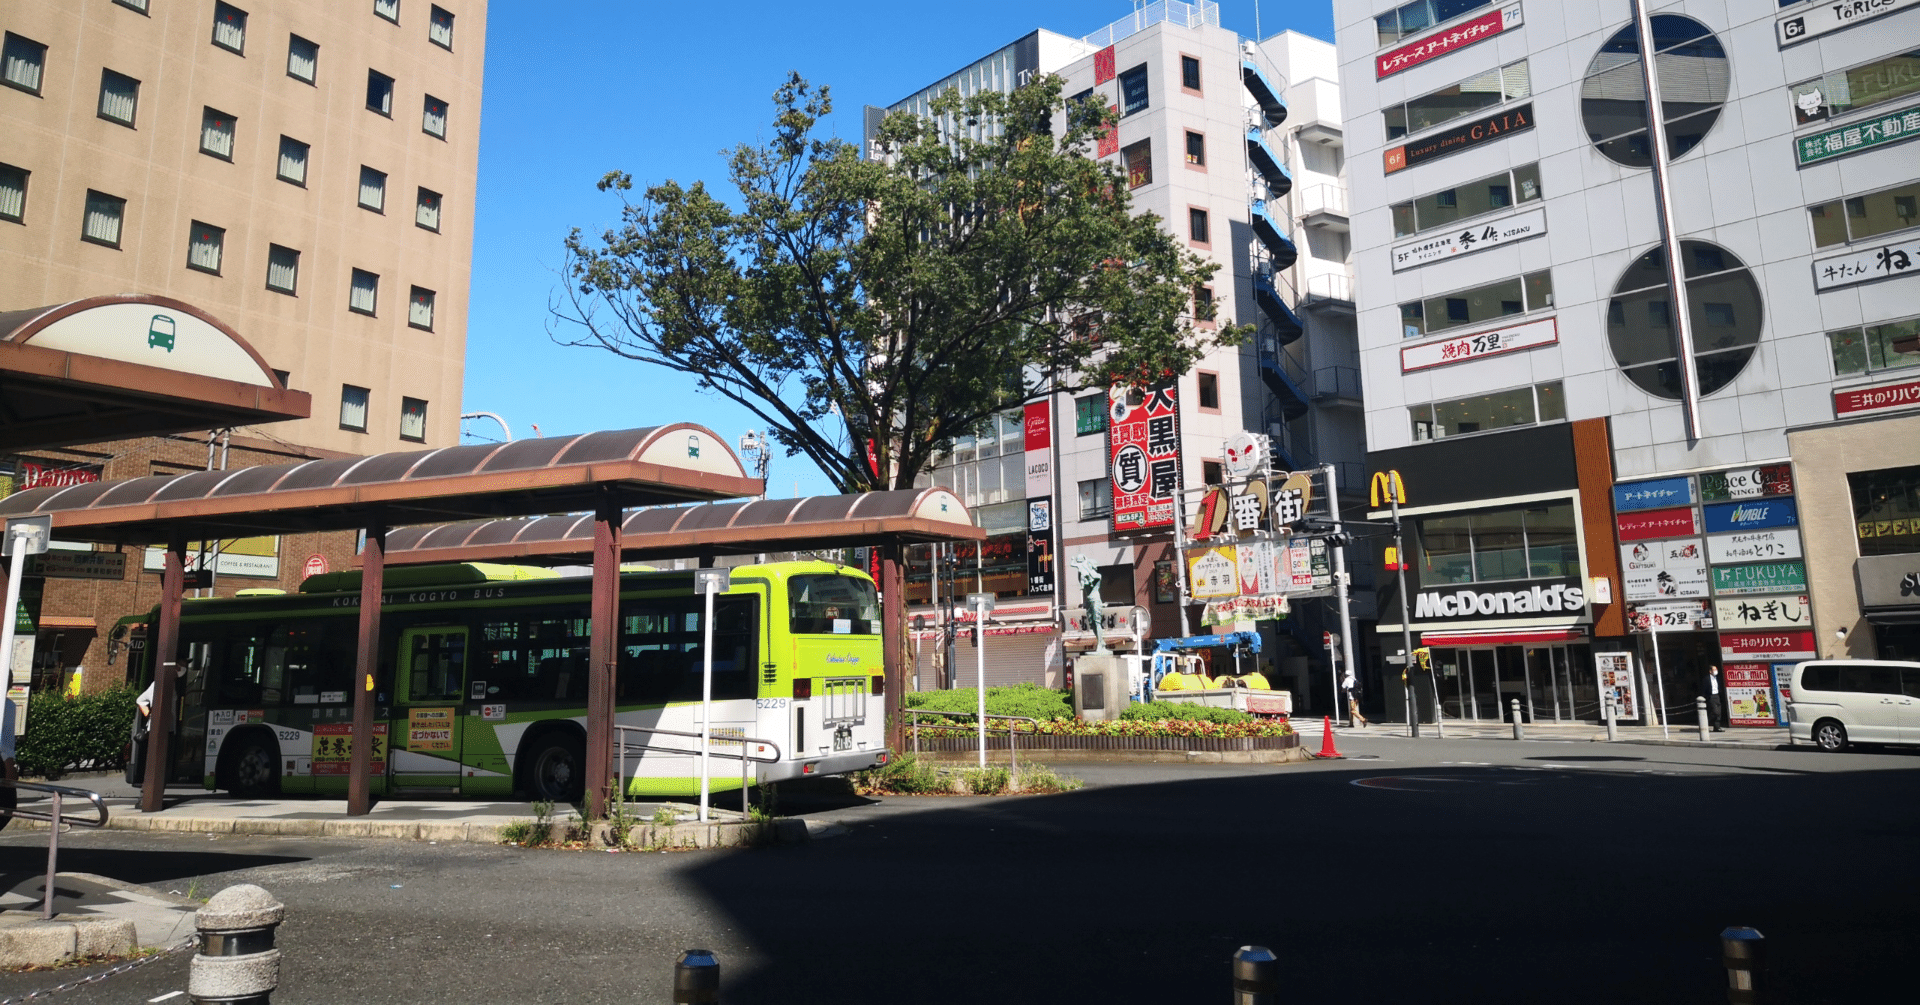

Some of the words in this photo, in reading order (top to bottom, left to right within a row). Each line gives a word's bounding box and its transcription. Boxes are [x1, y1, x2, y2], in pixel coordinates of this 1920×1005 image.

[1786, 22, 1803, 36] 6F
[1382, 46, 1425, 70] レディース
[1427, 22, 1496, 53] アートネイチャー
[1503, 9, 1520, 22] 7F
[1389, 153, 1401, 165] 6F
[1410, 142, 1438, 157] Luxury
[1440, 134, 1466, 148] dining
[1470, 112, 1527, 140] GAIA
[1825, 112, 1920, 152] 福屋不動産
[1398, 252, 1409, 262] 5F
[1503, 225, 1531, 238] KISAKU
[1823, 261, 1867, 281] 牛たん
[1877, 247, 1920, 275] ね
[1119, 422, 1146, 444] 買取
[1145, 378, 1178, 502] 大黒屋
[1028, 463, 1049, 475] LACOCO
[1119, 451, 1143, 487] 質
[1625, 489, 1678, 501] アートネイチャー
[1194, 488, 1303, 540] 1番街
[1754, 543, 1786, 557] とりこ
[1210, 574, 1231, 586] 赤羽
[1735, 564, 1798, 580] FUKUYA
[333, 595, 394, 607] KOKAI
[408, 590, 457, 602] KOGYO
[474, 588, 505, 599] BUS
[1415, 584, 1584, 618] McDonald's
[1738, 600, 1802, 625] ねぎし
[1731, 636, 1791, 648] 三井のリハウス
[491, 705, 504, 713] 出口
[757, 698, 786, 709] 5229
[279, 731, 300, 740] 5229
[411, 730, 449, 739] 近づかないで
